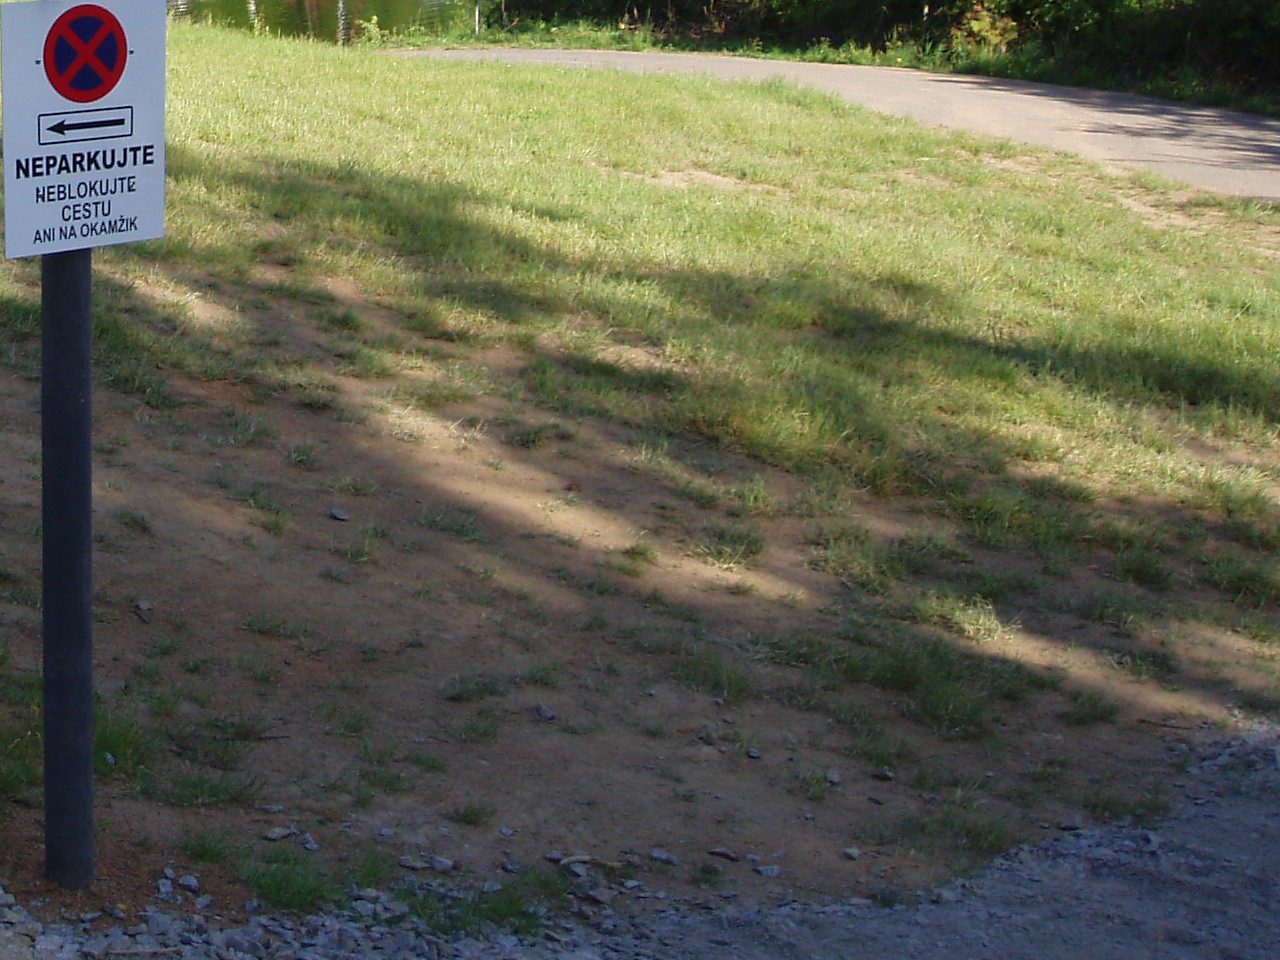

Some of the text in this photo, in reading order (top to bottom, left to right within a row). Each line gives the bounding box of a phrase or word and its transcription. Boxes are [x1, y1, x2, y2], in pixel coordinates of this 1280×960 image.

[15, 144, 155, 179] NEPARKUJTE
[35, 175, 137, 204] NEBLOKUJTE
[61, 200, 112, 222] CESTU
[33, 215, 138, 244] ANI NA OKAMŽIK
